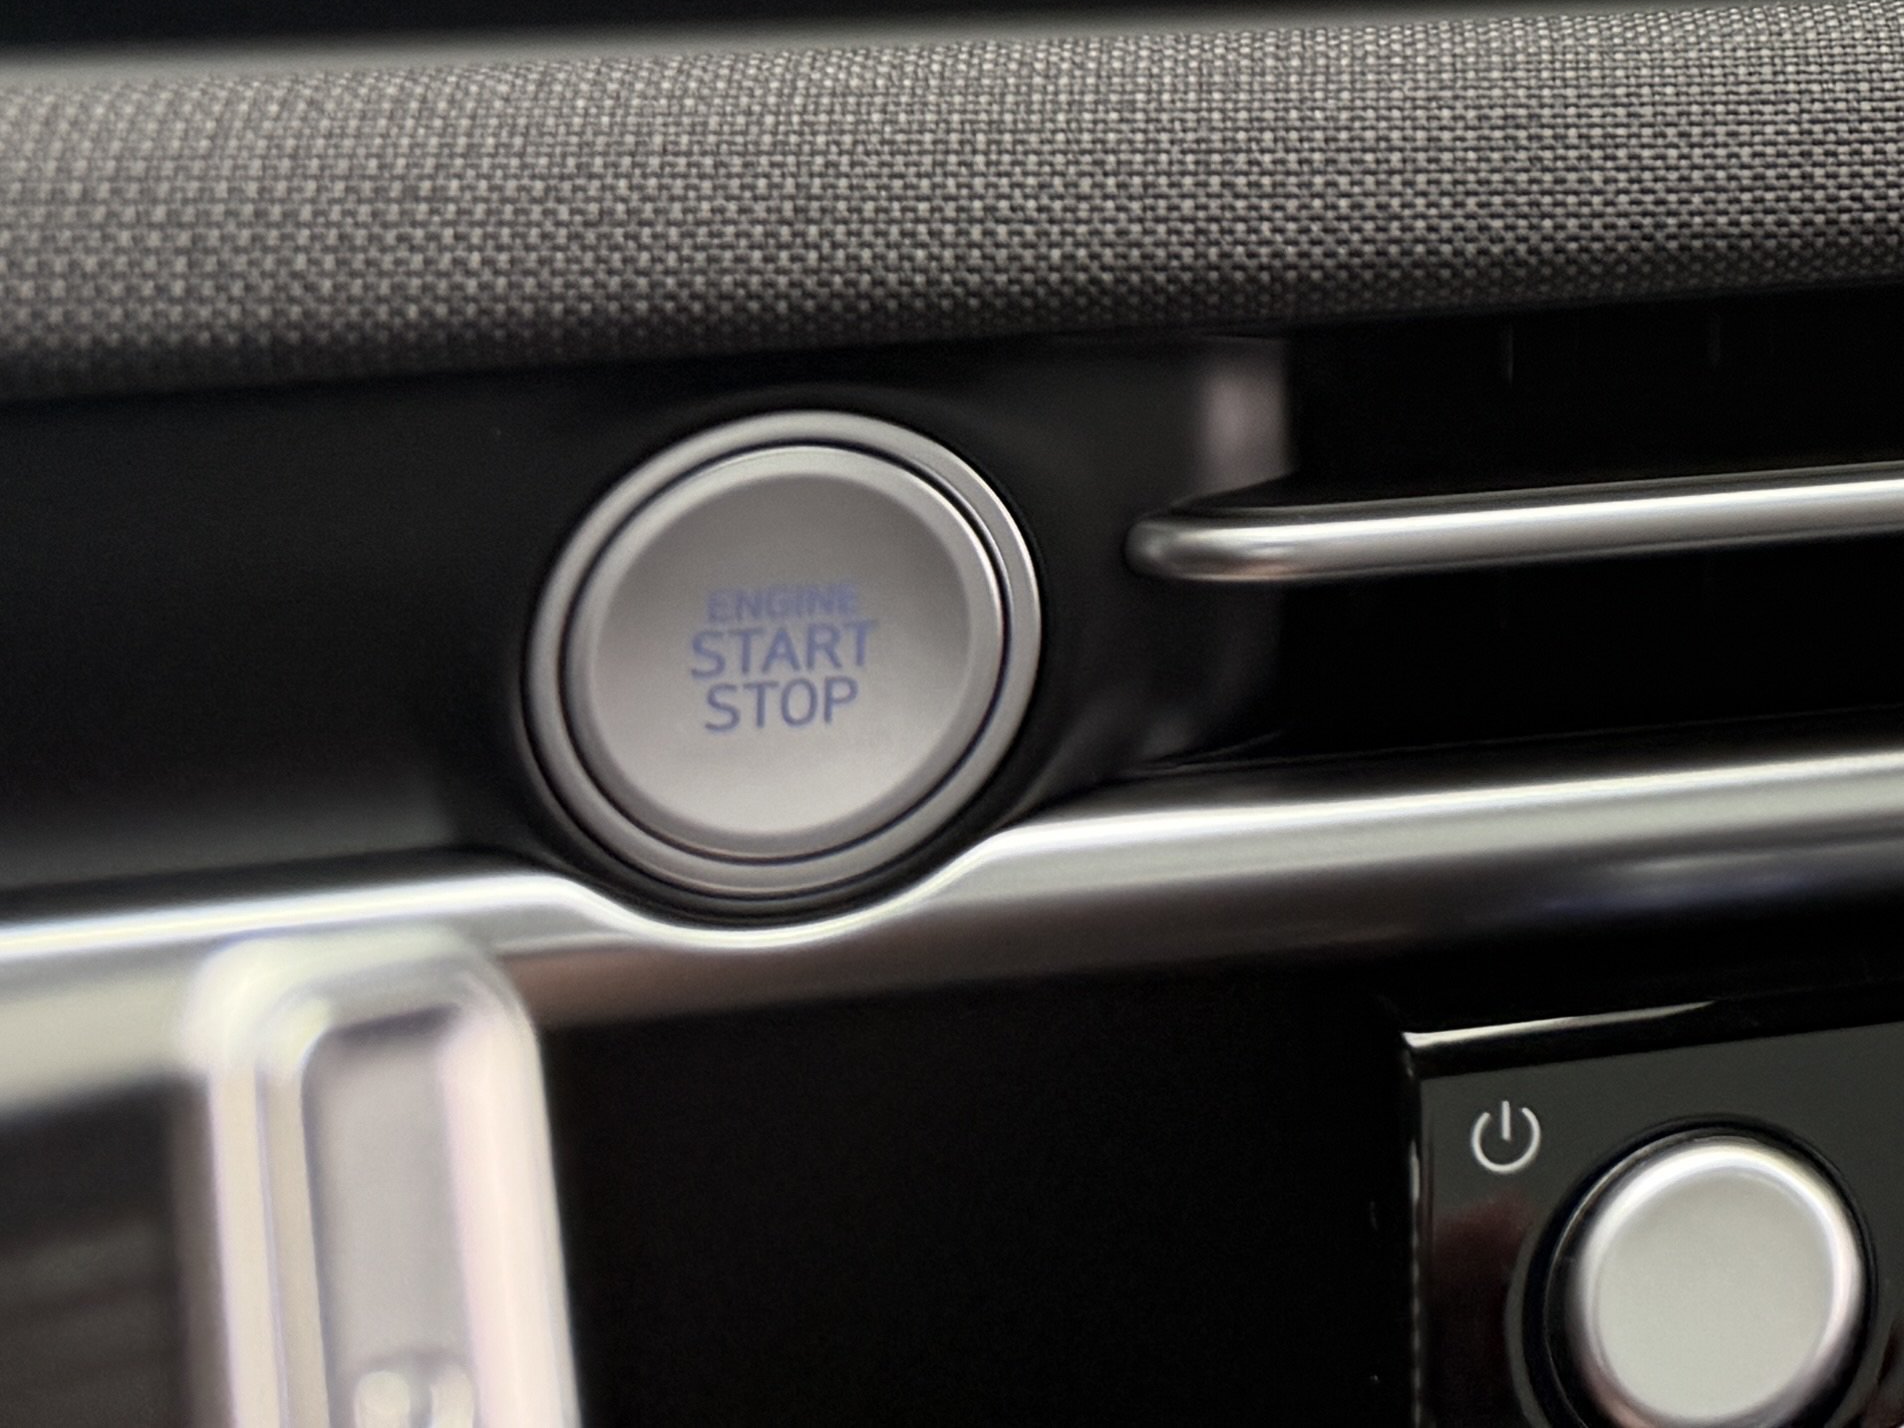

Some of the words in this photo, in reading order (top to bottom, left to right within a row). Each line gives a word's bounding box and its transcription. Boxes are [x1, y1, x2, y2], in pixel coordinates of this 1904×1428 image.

[707, 581, 857, 623] ENGINE
[690, 619, 880, 679] START
[704, 674, 859, 733] STOP
